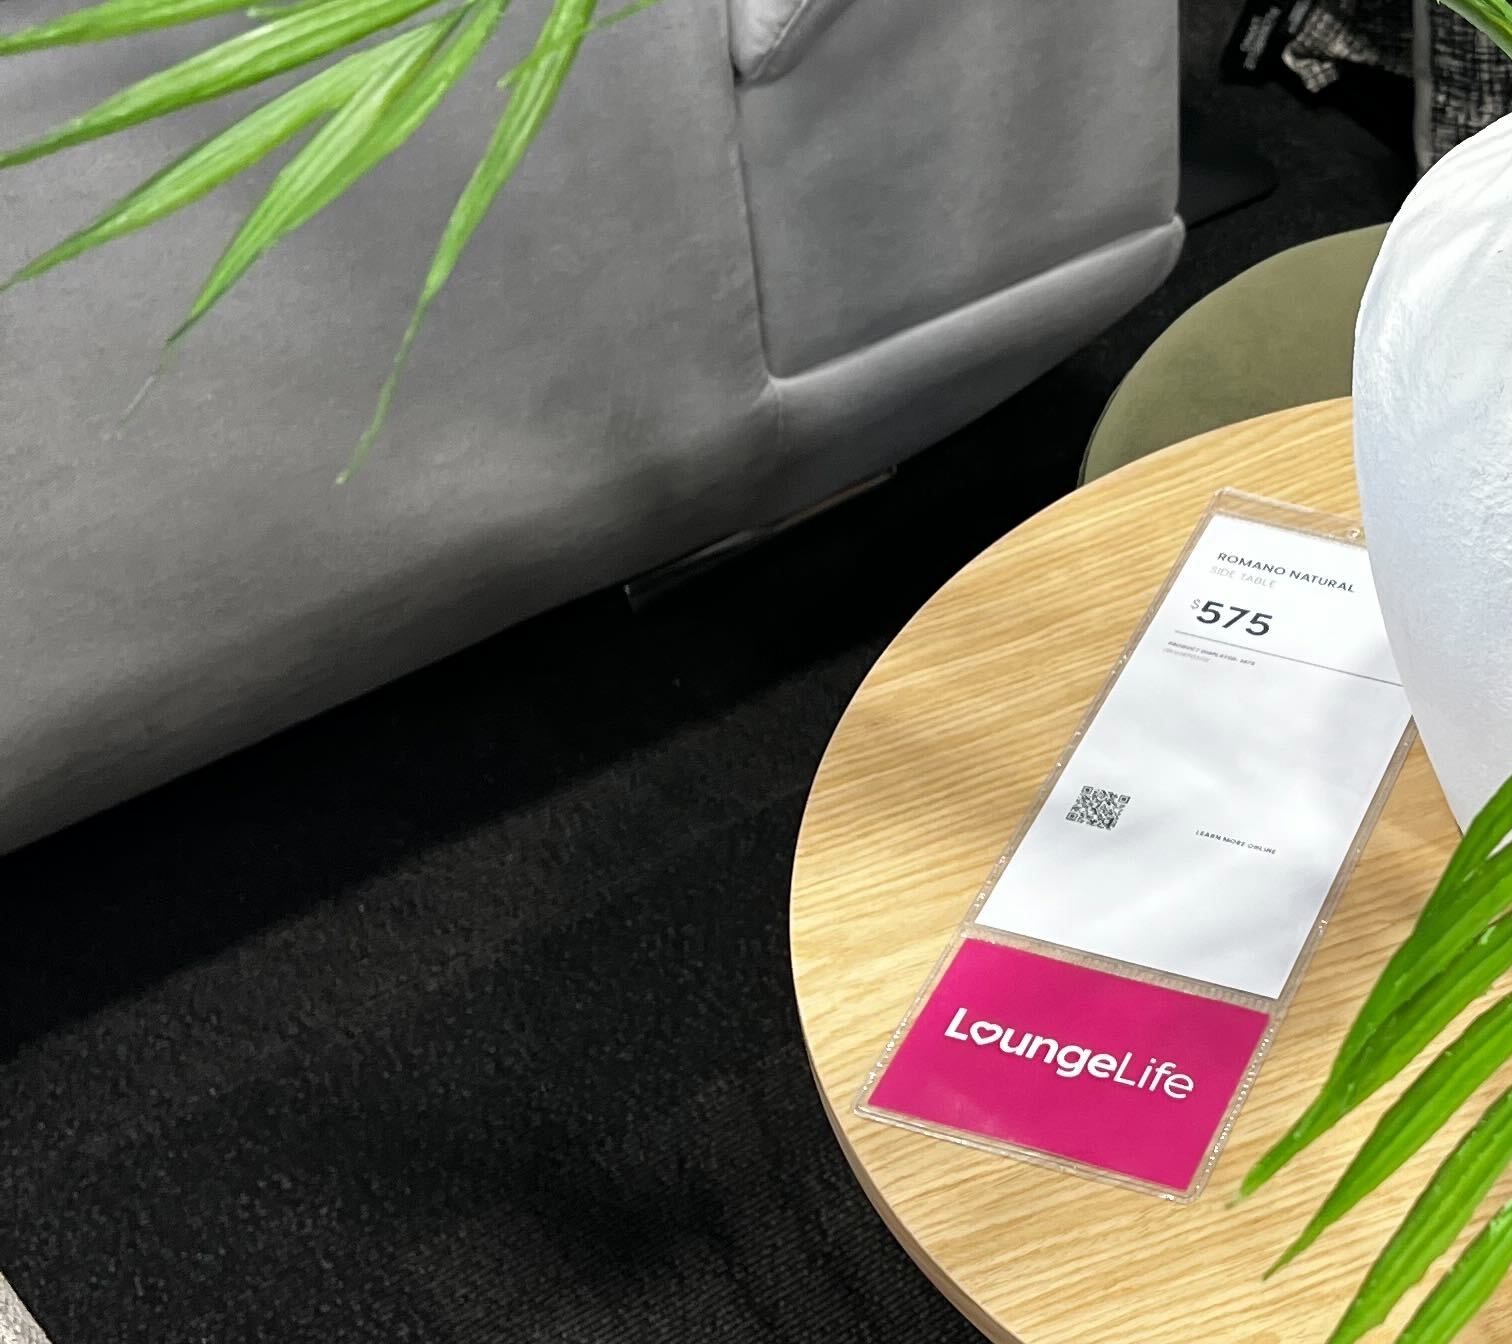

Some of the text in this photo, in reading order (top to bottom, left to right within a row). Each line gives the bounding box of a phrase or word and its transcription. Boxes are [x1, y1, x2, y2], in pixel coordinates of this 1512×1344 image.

[1210, 566, 1277, 589] SIDE TABLE
[1217, 552, 1355, 593] ROMANO NATURAL
[944, 1007, 1194, 1099] LoungeLife
